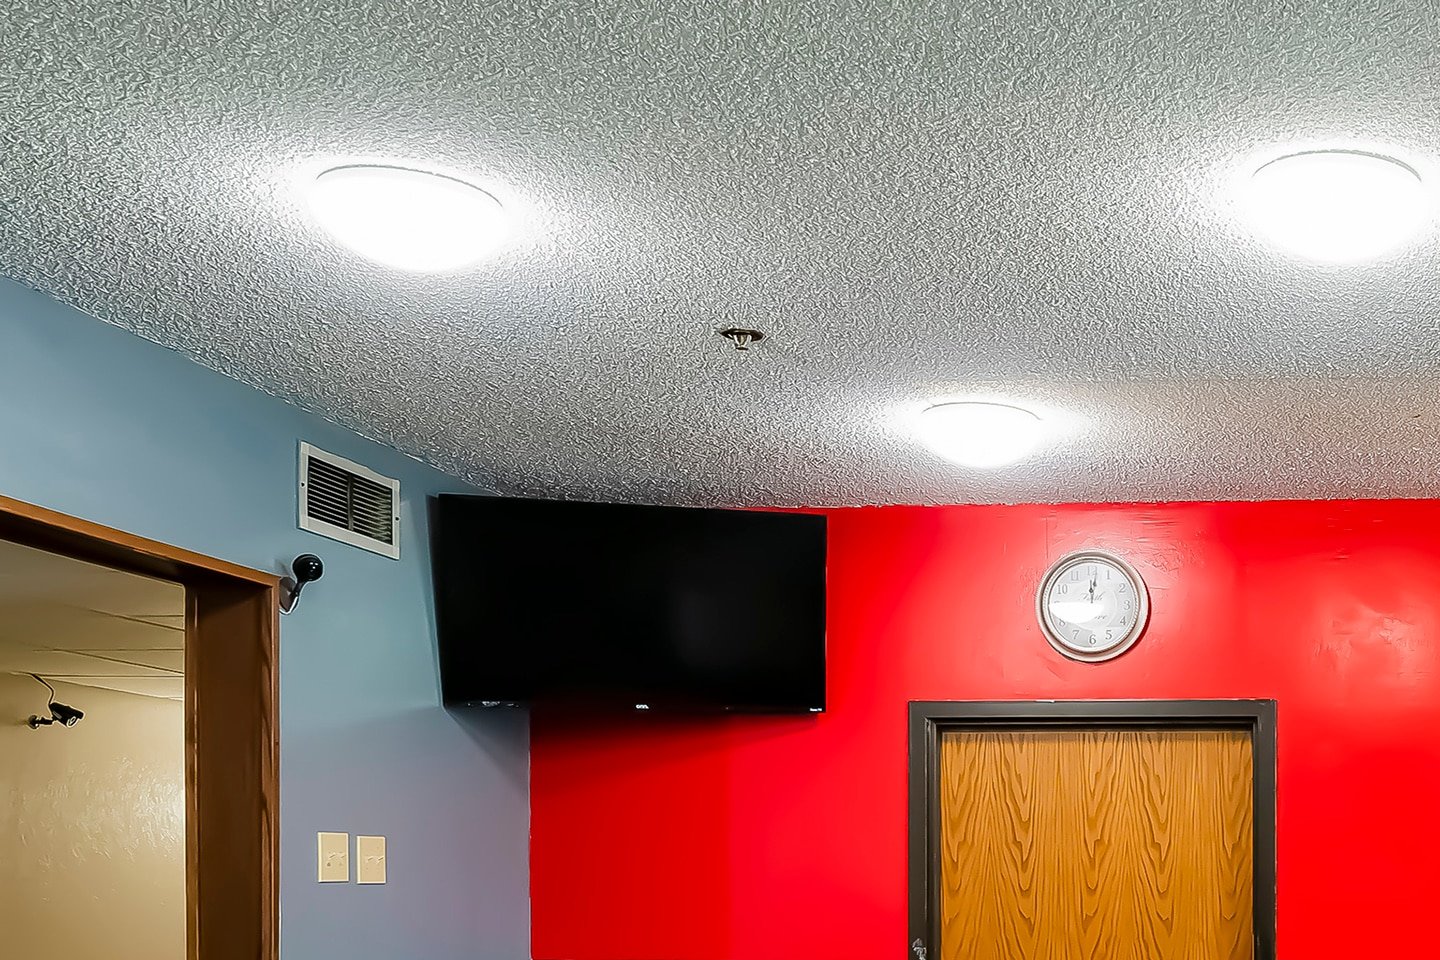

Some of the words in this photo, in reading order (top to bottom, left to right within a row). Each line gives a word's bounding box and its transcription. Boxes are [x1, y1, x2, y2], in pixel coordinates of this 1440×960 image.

[1070, 570, 1080, 581] 11
[1087, 565, 1098, 576] 12
[1106, 569, 1111, 580] 1
[1056, 583, 1068, 595] 10
[1118, 582, 1126, 593] 2
[1123, 599, 1131, 611] 3
[1119, 615, 1127, 626] 4
[1072, 629, 1080, 640] 7
[1088, 634, 1097, 645] 6
[1105, 629, 1113, 640] 5
